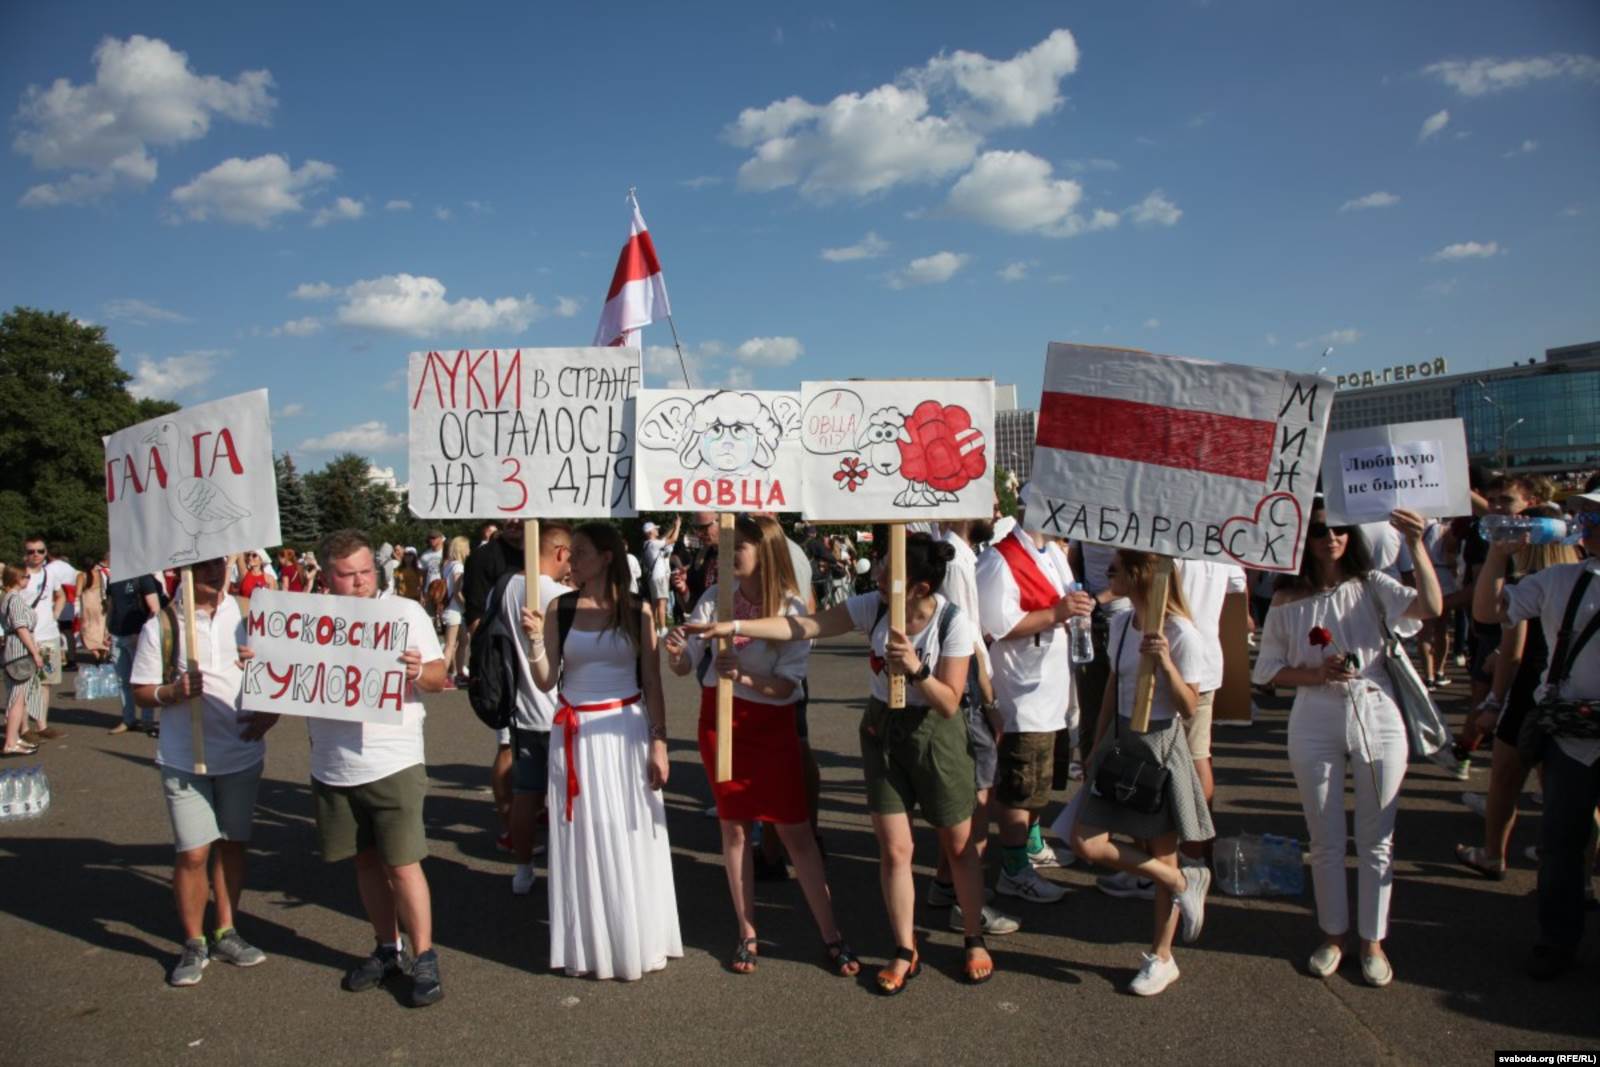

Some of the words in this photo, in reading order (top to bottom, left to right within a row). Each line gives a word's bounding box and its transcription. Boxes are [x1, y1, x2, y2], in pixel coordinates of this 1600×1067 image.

[412, 349, 521, 410] ЛУКИ
[558, 366, 640, 401] СТРАНЕ
[1336, 357, 1447, 389] РОД-ГЕРОЙ
[192, 427, 244, 478] ГА
[439, 404, 628, 461] ОСТАЛОСЬ
[429, 463, 478, 514] НА
[497, 458, 528, 511] 3
[548, 456, 633, 510] ДНЯ
[1260, 382, 1318, 564] МИНСК
[1345, 454, 1434, 472] Любимую
[663, 478, 683, 505] Я
[692, 478, 786, 509] ОВЦА
[1348, 483, 1367, 494] не
[248, 610, 409, 652] МОСКОВСКИЙ
[244, 661, 404, 711] КУКЛОВОД
